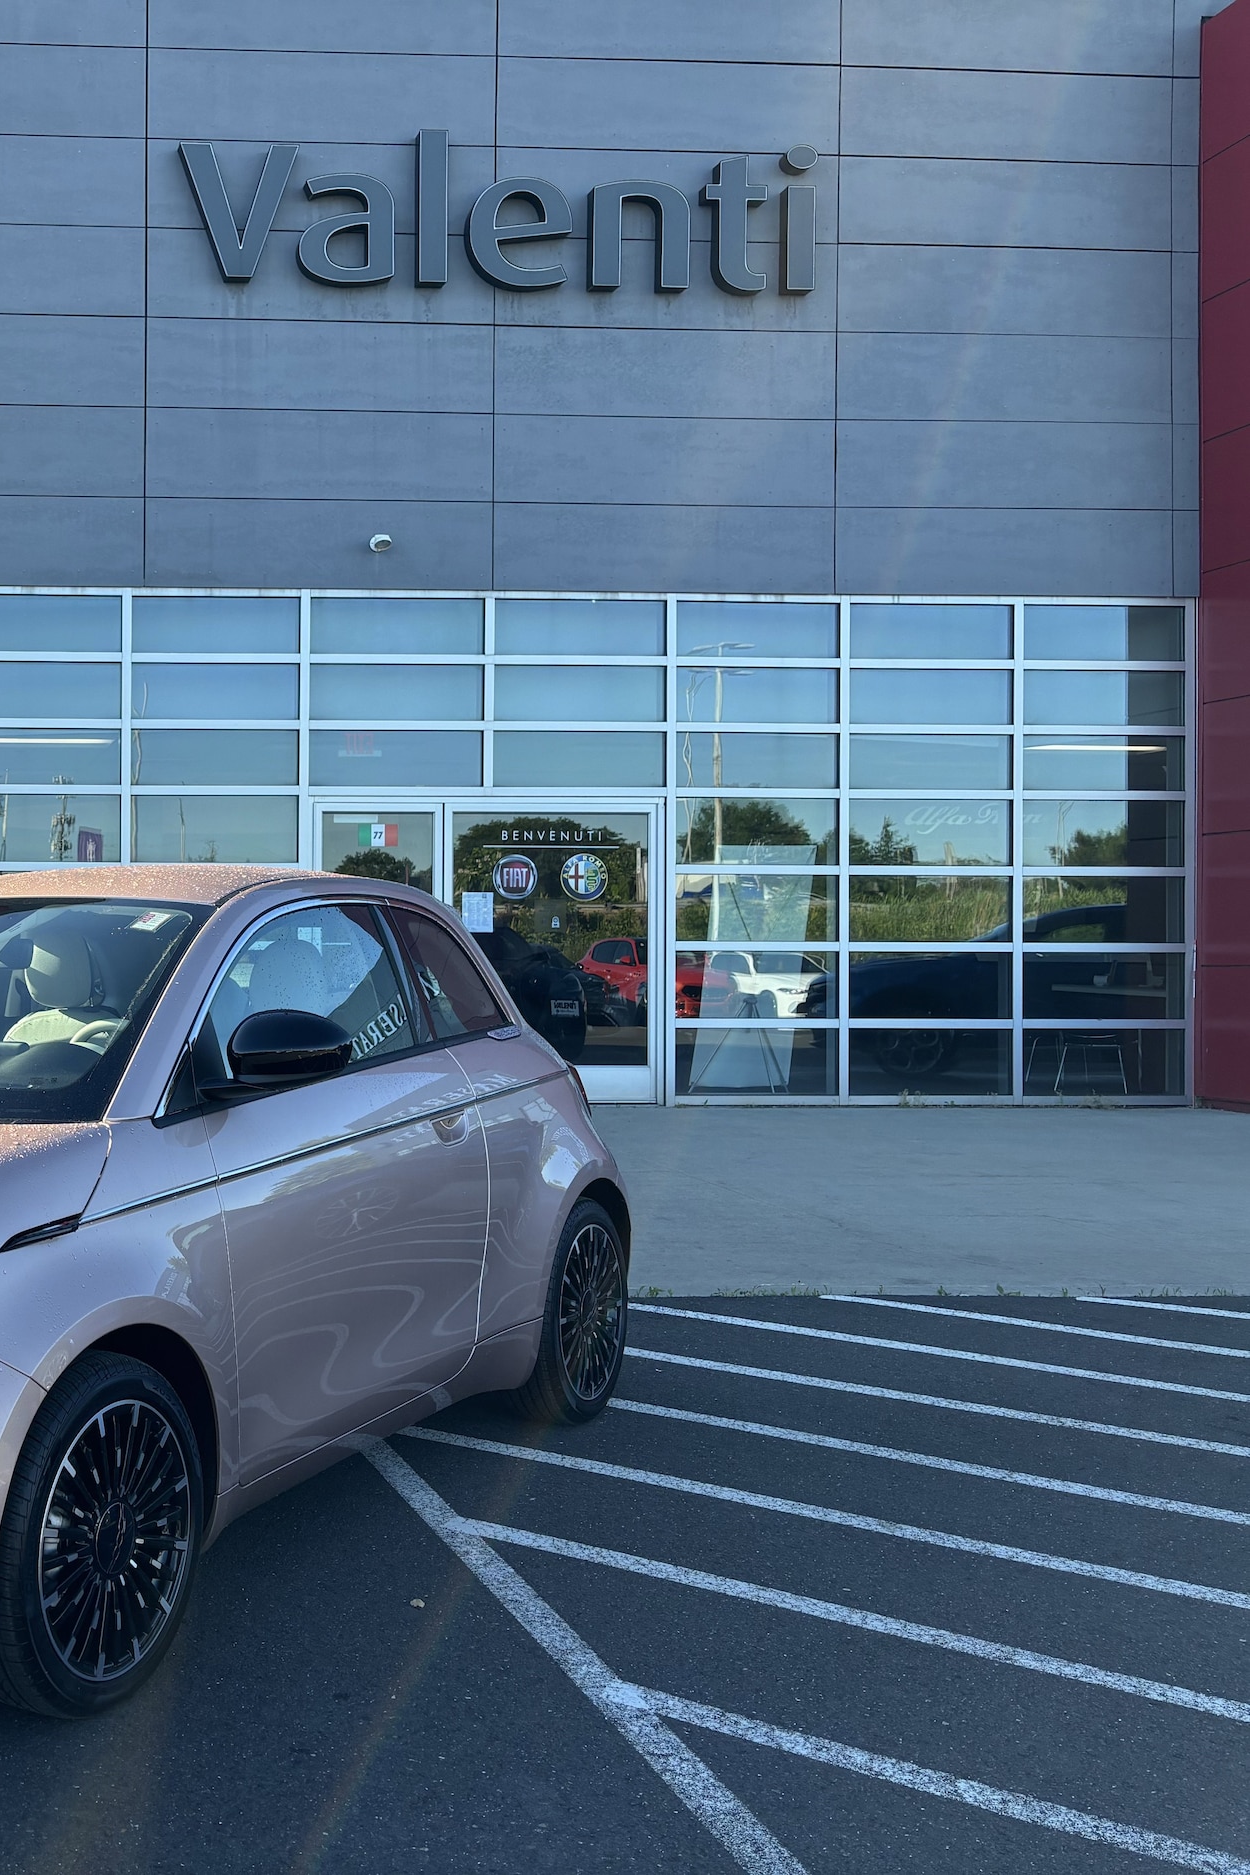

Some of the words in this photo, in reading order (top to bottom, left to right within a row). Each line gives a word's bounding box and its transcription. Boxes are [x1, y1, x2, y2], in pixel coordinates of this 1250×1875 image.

[178, 129, 818, 296] Valenti
[373, 831, 384, 840] 77
[501, 830, 603, 842] BENVENUTI
[503, 867, 529, 888] FIAT
[562, 855, 581, 880] ALFA
[582, 854, 608, 881] ROMEO
